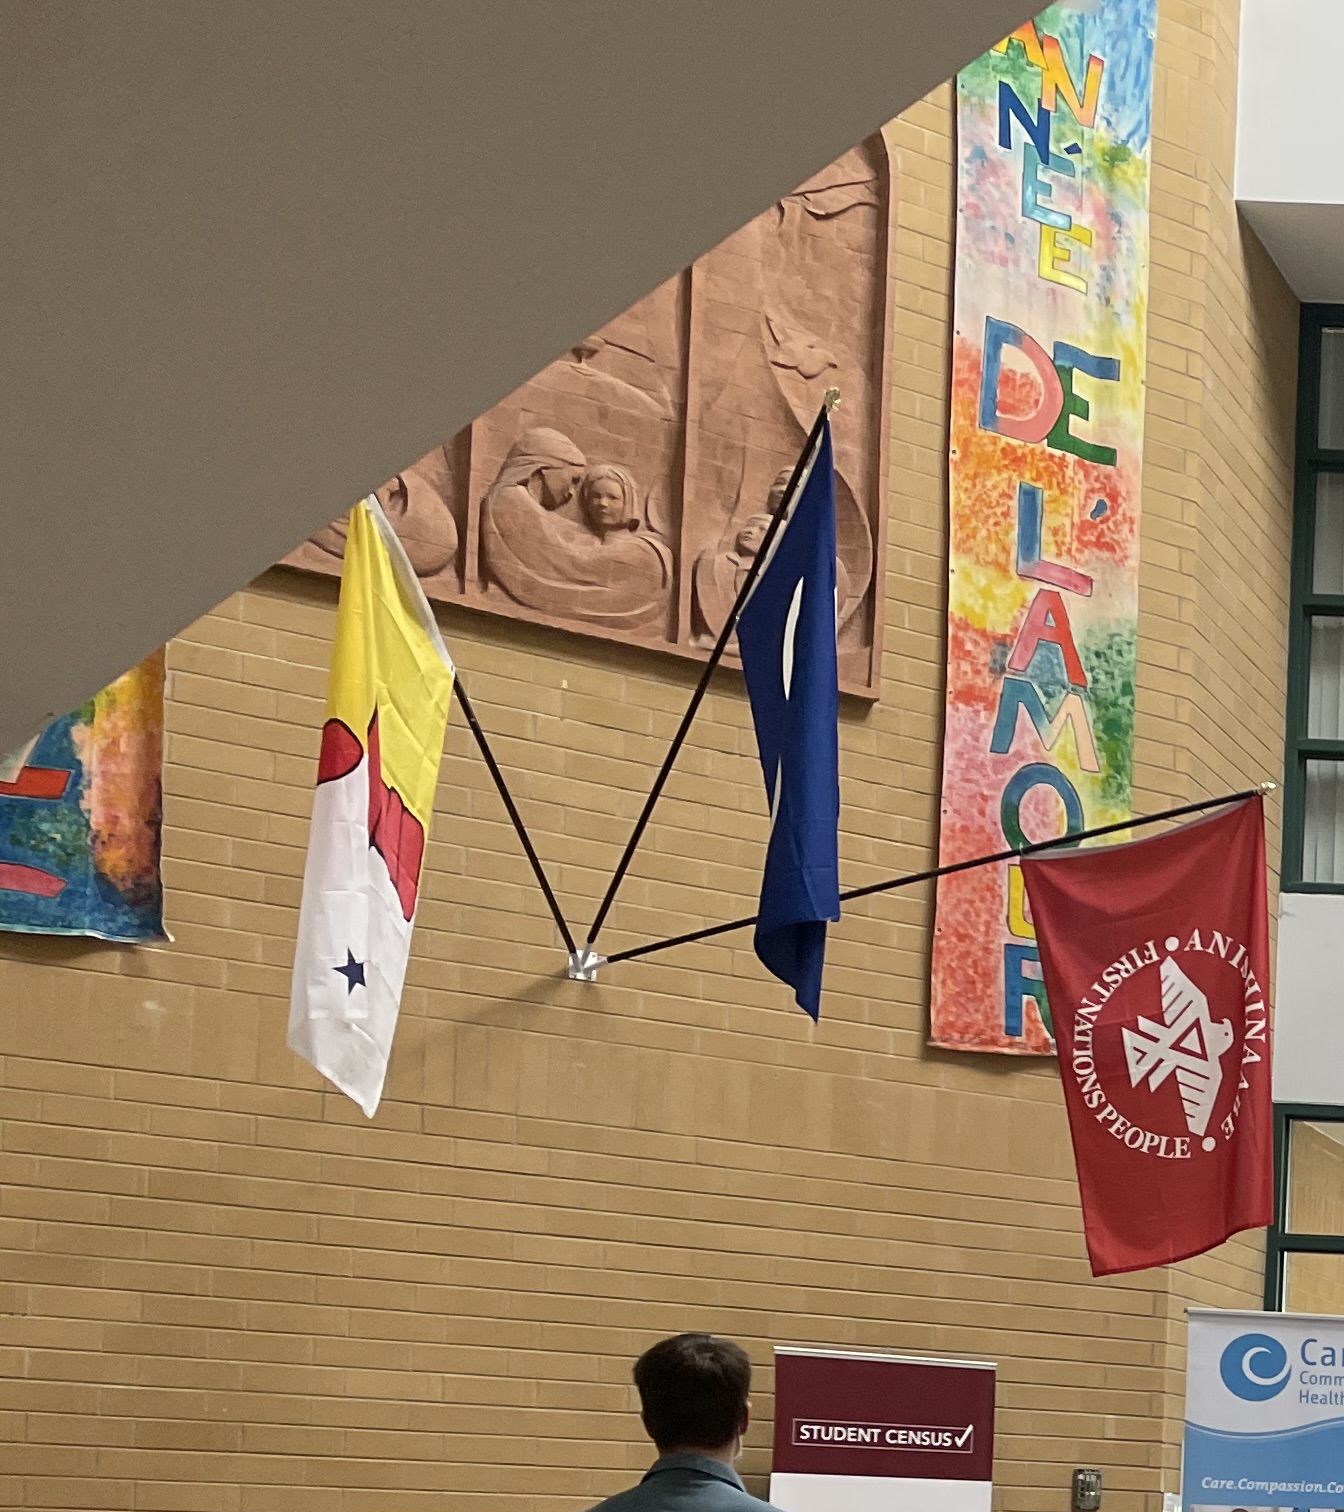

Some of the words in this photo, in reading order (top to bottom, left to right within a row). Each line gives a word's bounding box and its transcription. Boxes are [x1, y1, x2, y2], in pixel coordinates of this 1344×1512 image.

[978, 315, 1120, 465] DE
[1091, 940, 1160, 1004] FIRST
[1071, 997, 1106, 1109] NATIONS
[1095, 1107, 1191, 1159] PEOPLE
[799, 1423, 881, 1445] STUDENT
[885, 1427, 952, 1448] CENSUS
